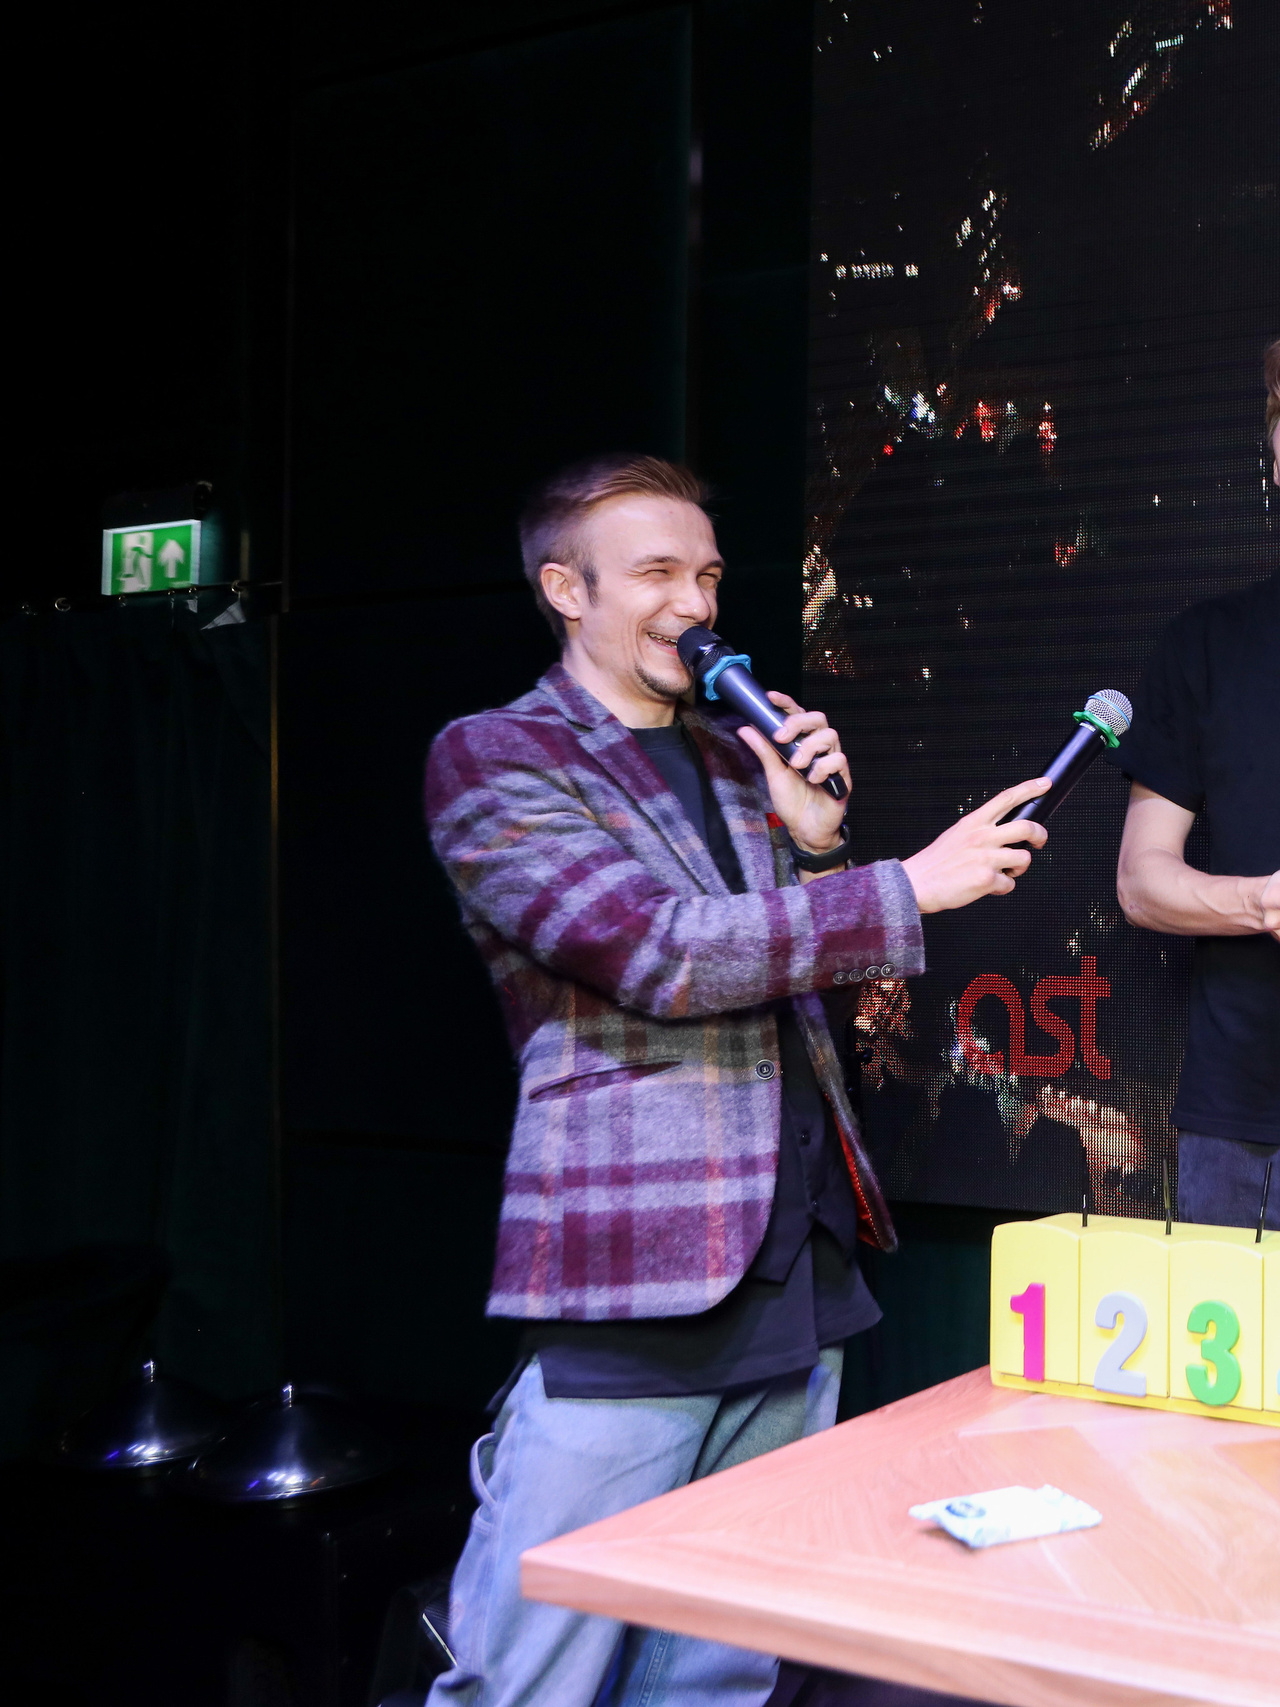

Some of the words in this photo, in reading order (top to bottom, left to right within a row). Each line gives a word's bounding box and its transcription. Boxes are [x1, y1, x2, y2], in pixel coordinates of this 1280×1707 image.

[1010, 1282, 1046, 1382] 1
[1093, 1291, 1148, 1398] 2
[1185, 1300, 1241, 1407] 3
